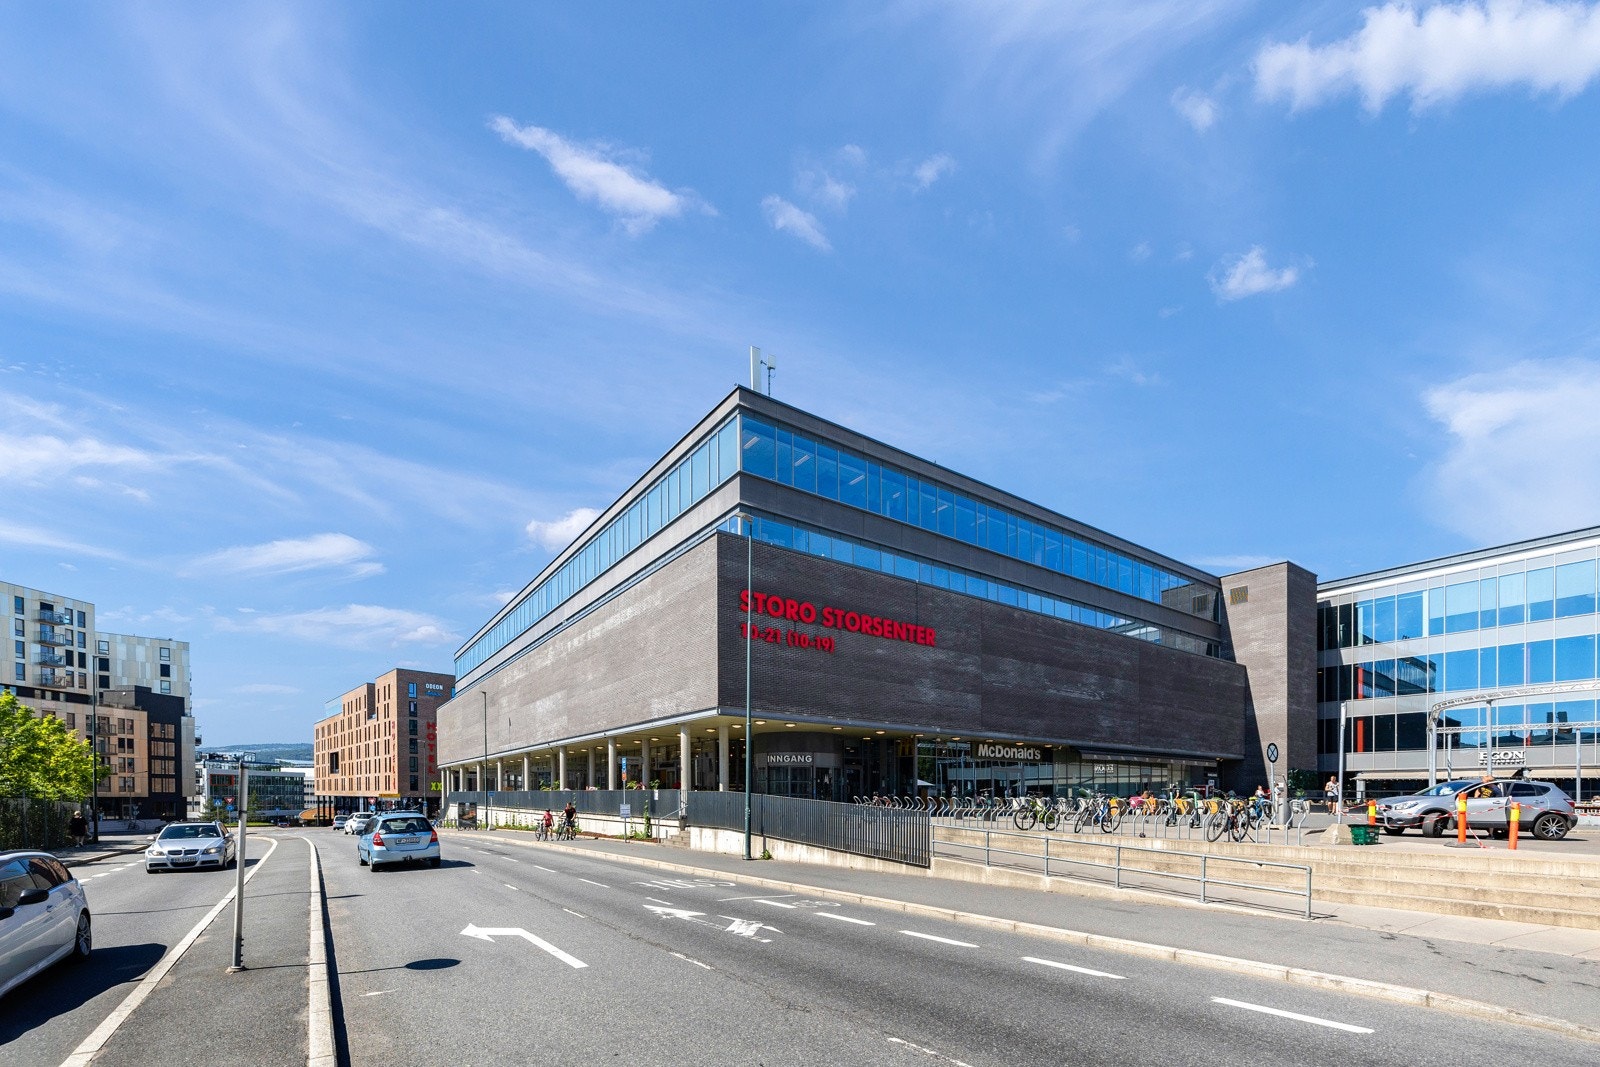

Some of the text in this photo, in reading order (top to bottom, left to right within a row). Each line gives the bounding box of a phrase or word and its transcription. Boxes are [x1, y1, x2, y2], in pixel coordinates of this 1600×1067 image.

[740, 589, 937, 648] STORO STORSENTER
[740, 622, 836, 653] 10-21 (10-19)
[767, 755, 813, 763] INNGANG
[978, 744, 1041, 760] McDonald's
